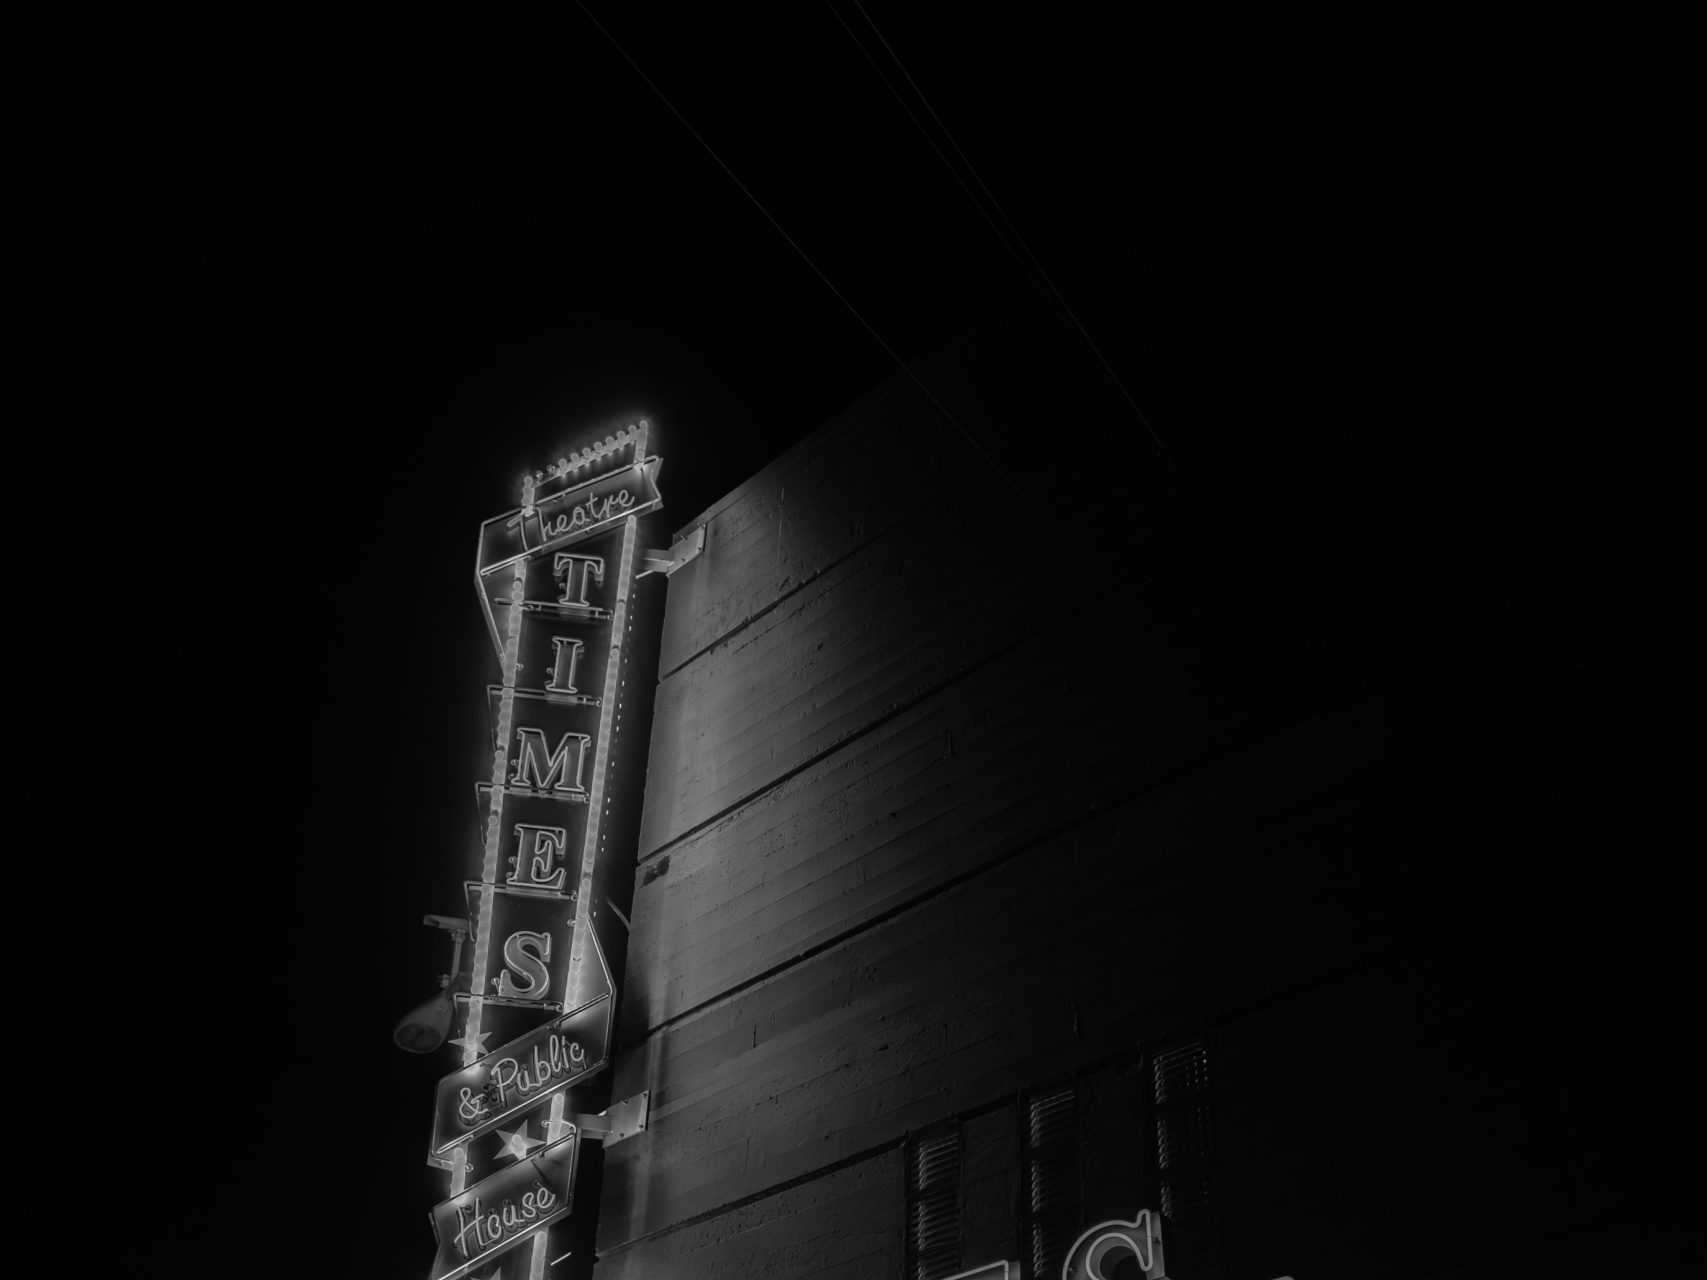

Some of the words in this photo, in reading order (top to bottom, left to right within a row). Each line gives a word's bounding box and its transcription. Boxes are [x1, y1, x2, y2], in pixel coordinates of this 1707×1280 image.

[506, 488, 635, 551] Theatre
[499, 552, 604, 999] TIMES
[458, 1086, 489, 1120] &
[490, 1034, 587, 1104] Public
[453, 1188, 556, 1257] House
